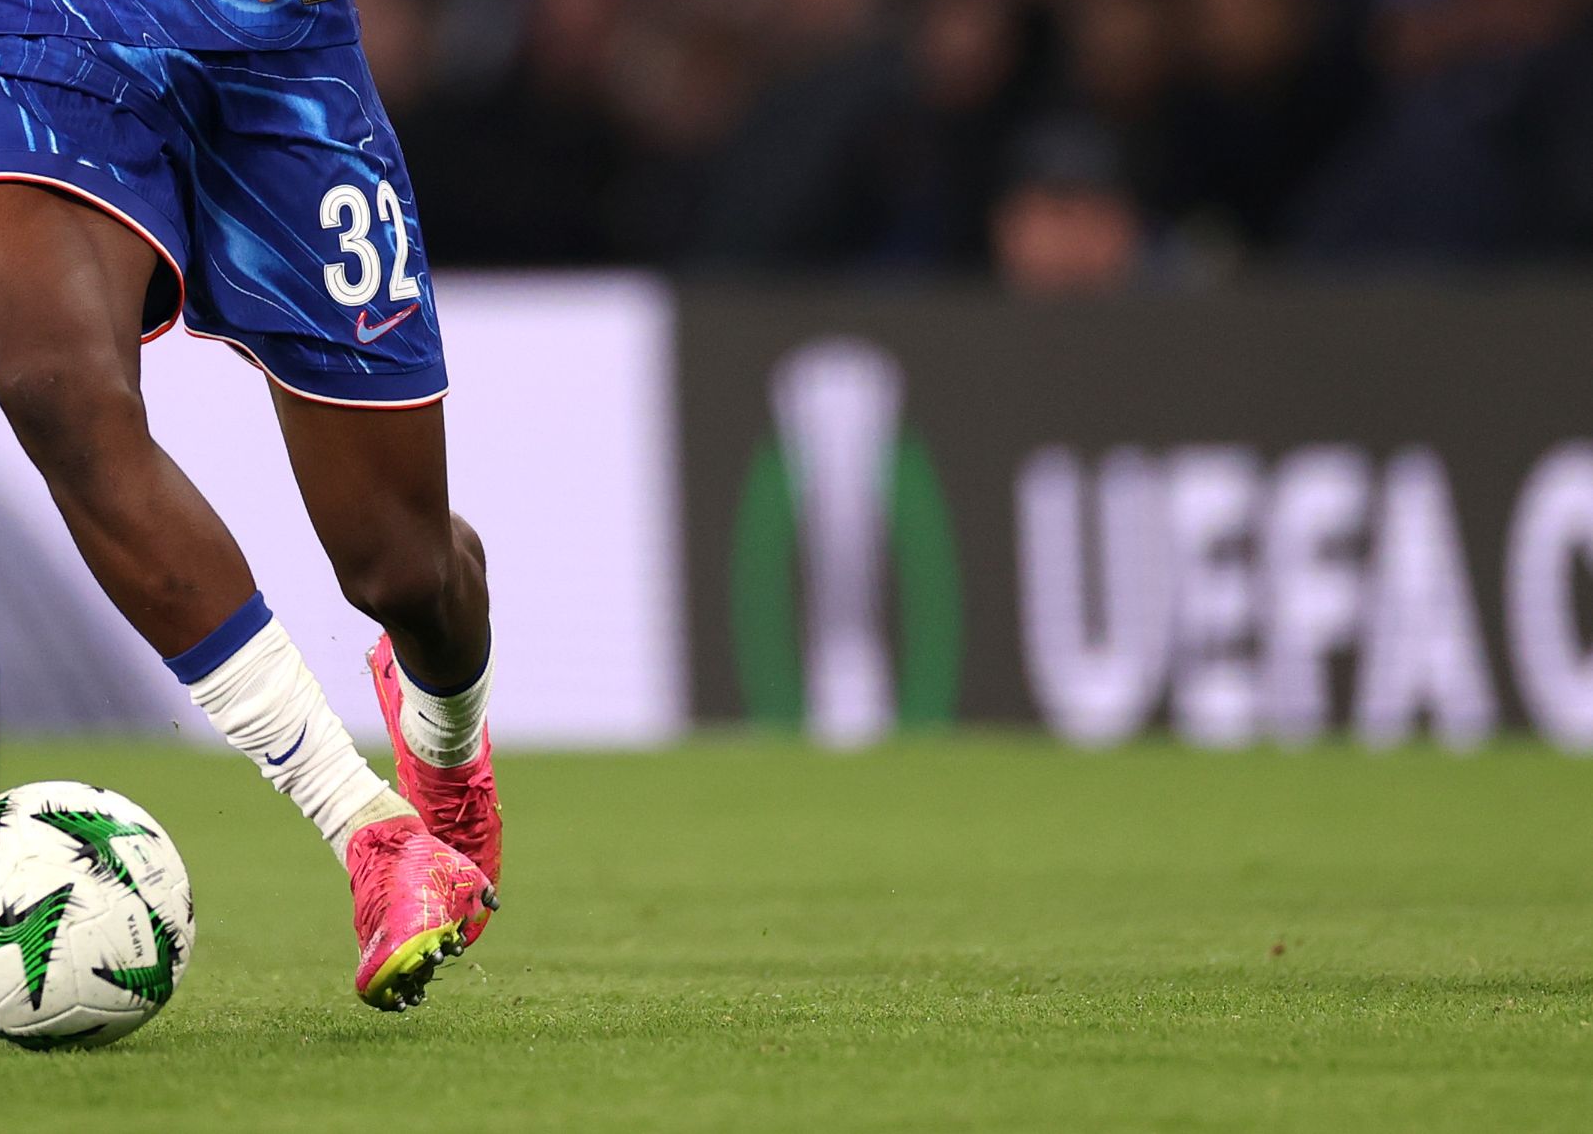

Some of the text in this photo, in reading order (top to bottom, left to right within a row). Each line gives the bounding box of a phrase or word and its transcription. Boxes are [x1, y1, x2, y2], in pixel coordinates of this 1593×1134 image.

[319, 179, 421, 307] 32
[1017, 446, 1497, 750] UEFA
[127, 913, 143, 958] KIPSTA
